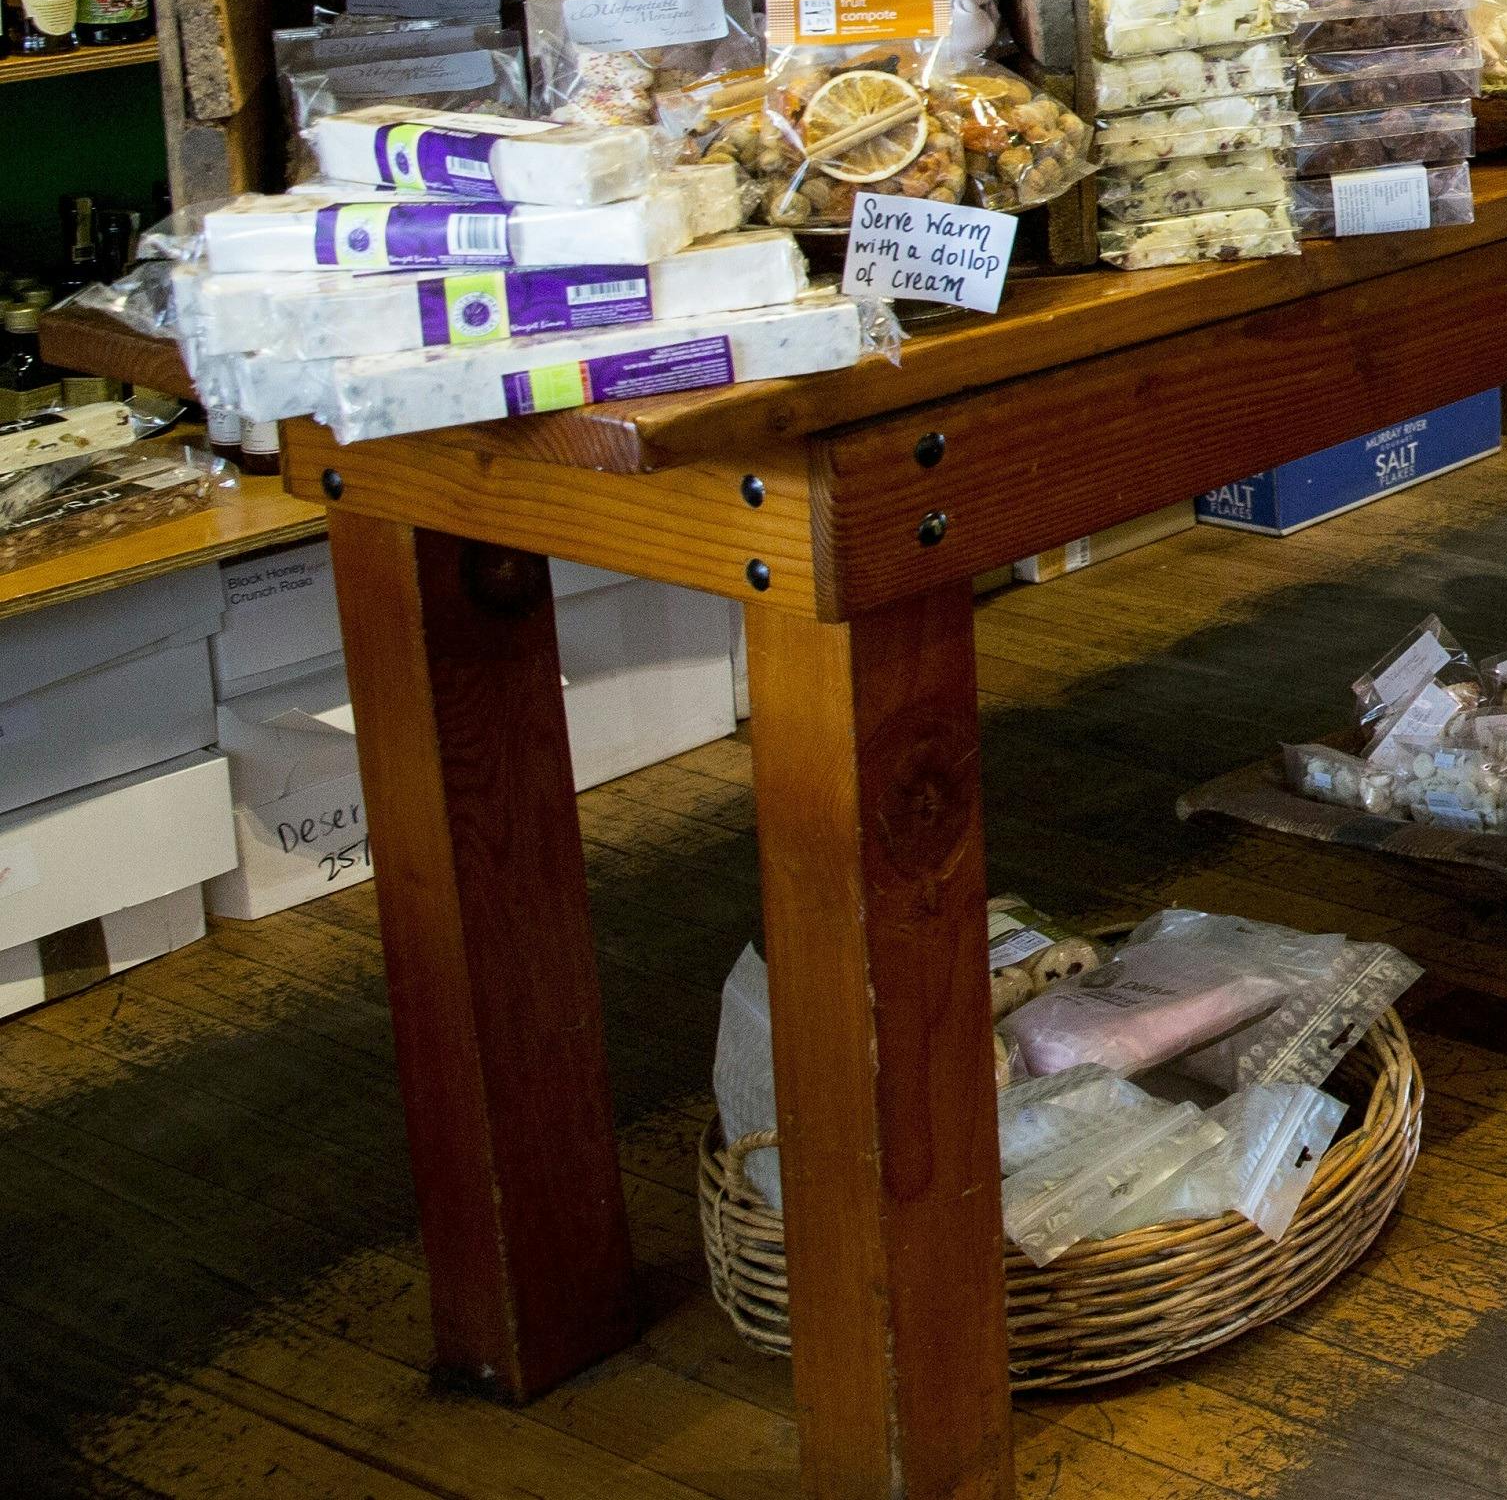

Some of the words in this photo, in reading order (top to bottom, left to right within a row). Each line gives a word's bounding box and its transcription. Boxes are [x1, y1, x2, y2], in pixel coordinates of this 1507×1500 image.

[841, 10, 898, 23] compote
[861, 198, 913, 232] Serve
[926, 212, 991, 251] Warm
[855, 238, 900, 262] with
[908, 245, 921, 259] a
[931, 244, 1000, 279] dollop
[856, 262, 877, 287] of
[892, 270, 965, 301] cream
[1366, 427, 1402, 450] MURRAY
[1404, 419, 1428, 436] RIVER
[1375, 442, 1419, 477] SALT
[1378, 465, 1416, 487] FLAKES
[1210, 503, 1252, 520] FLAKES
[267, 564, 305, 579] Honey
[230, 586, 277, 604] Crunch
